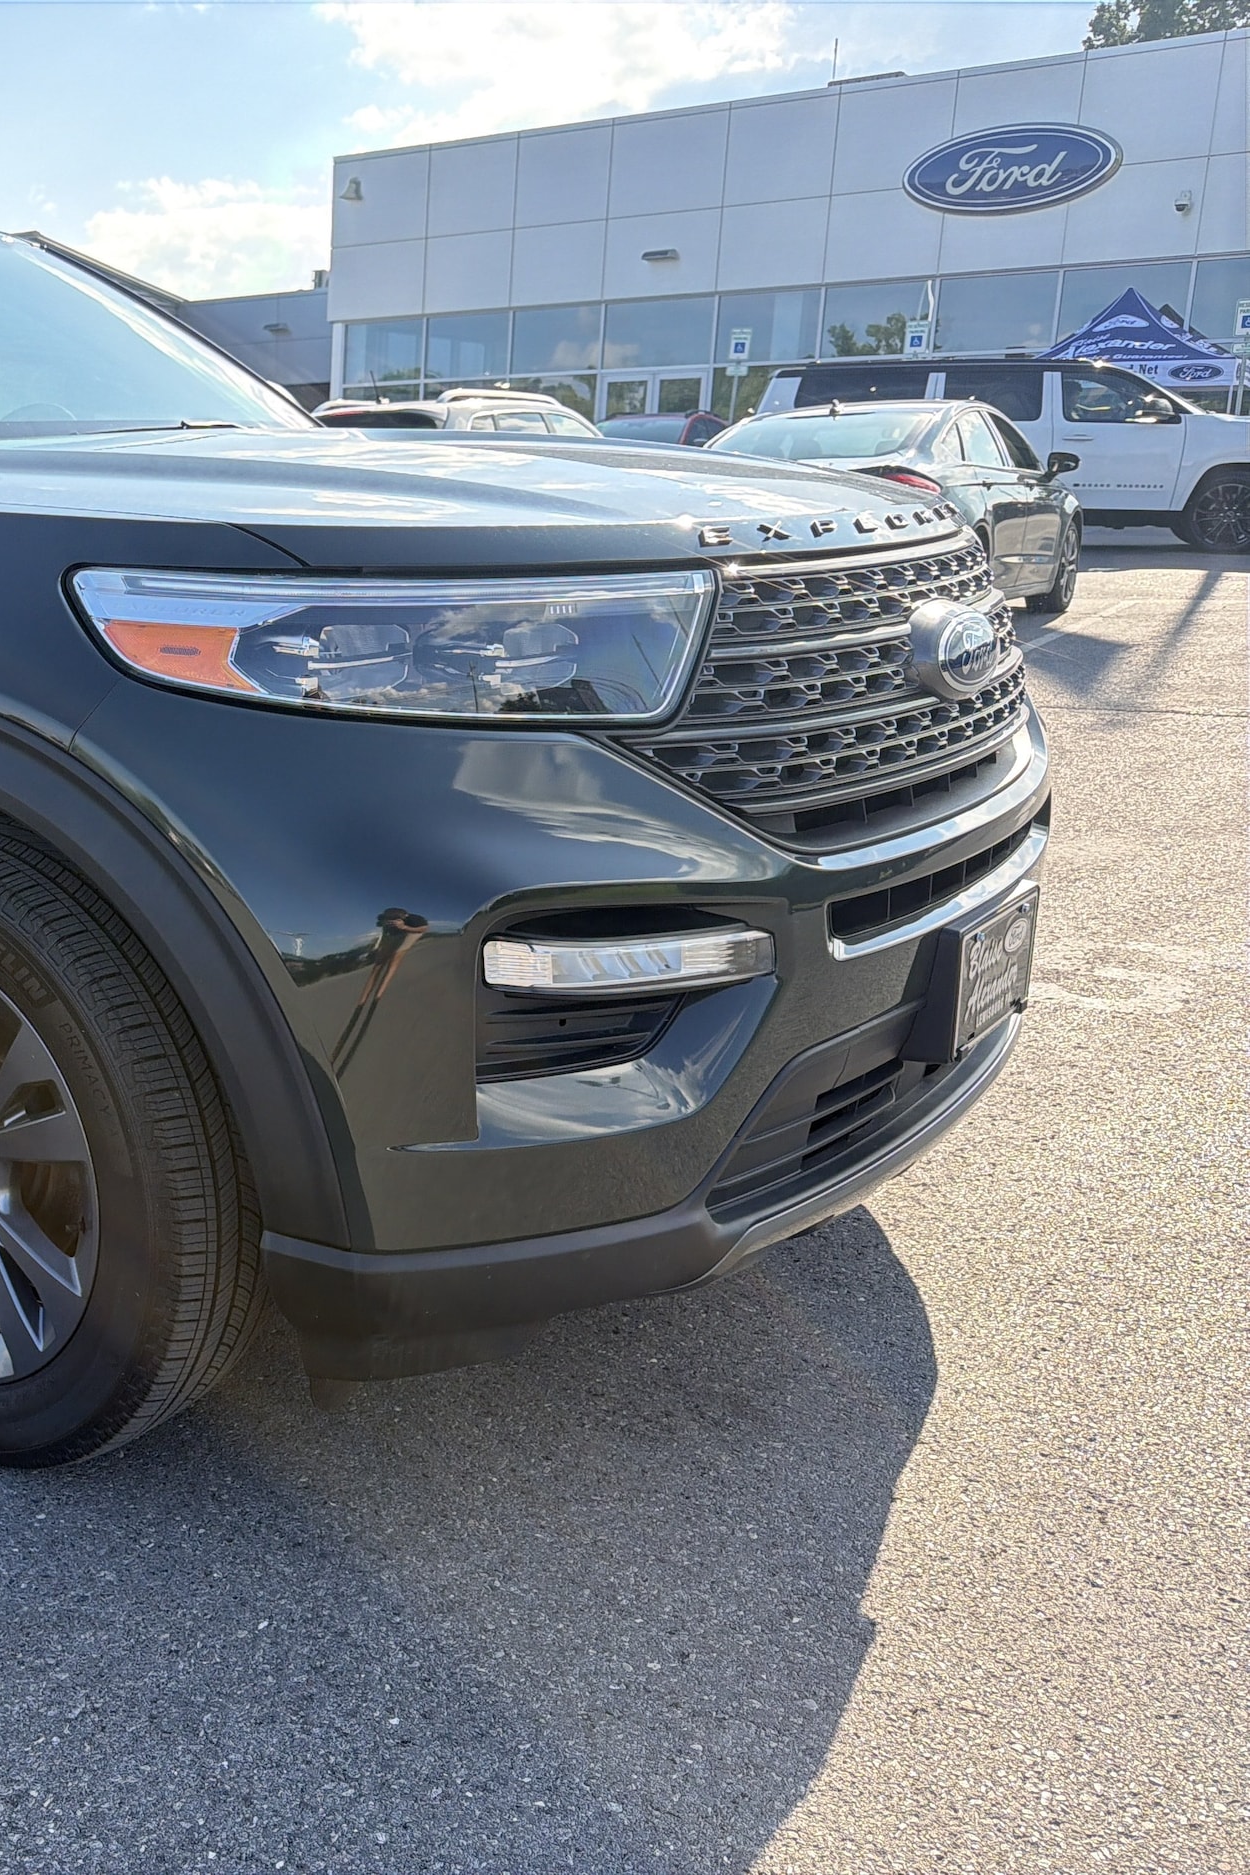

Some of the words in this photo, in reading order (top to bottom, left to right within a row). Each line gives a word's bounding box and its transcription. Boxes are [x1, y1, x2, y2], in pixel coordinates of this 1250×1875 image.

[945, 143, 1067, 196] Ford
[1053, 338, 1177, 360] Alexander
[1178, 364, 1213, 382] Ford
[961, 629, 996, 676] Ford
[968, 937, 1004, 981] Blaise
[964, 957, 1018, 1024] Alexander
[58, 1023, 111, 1115] PRIMACY
